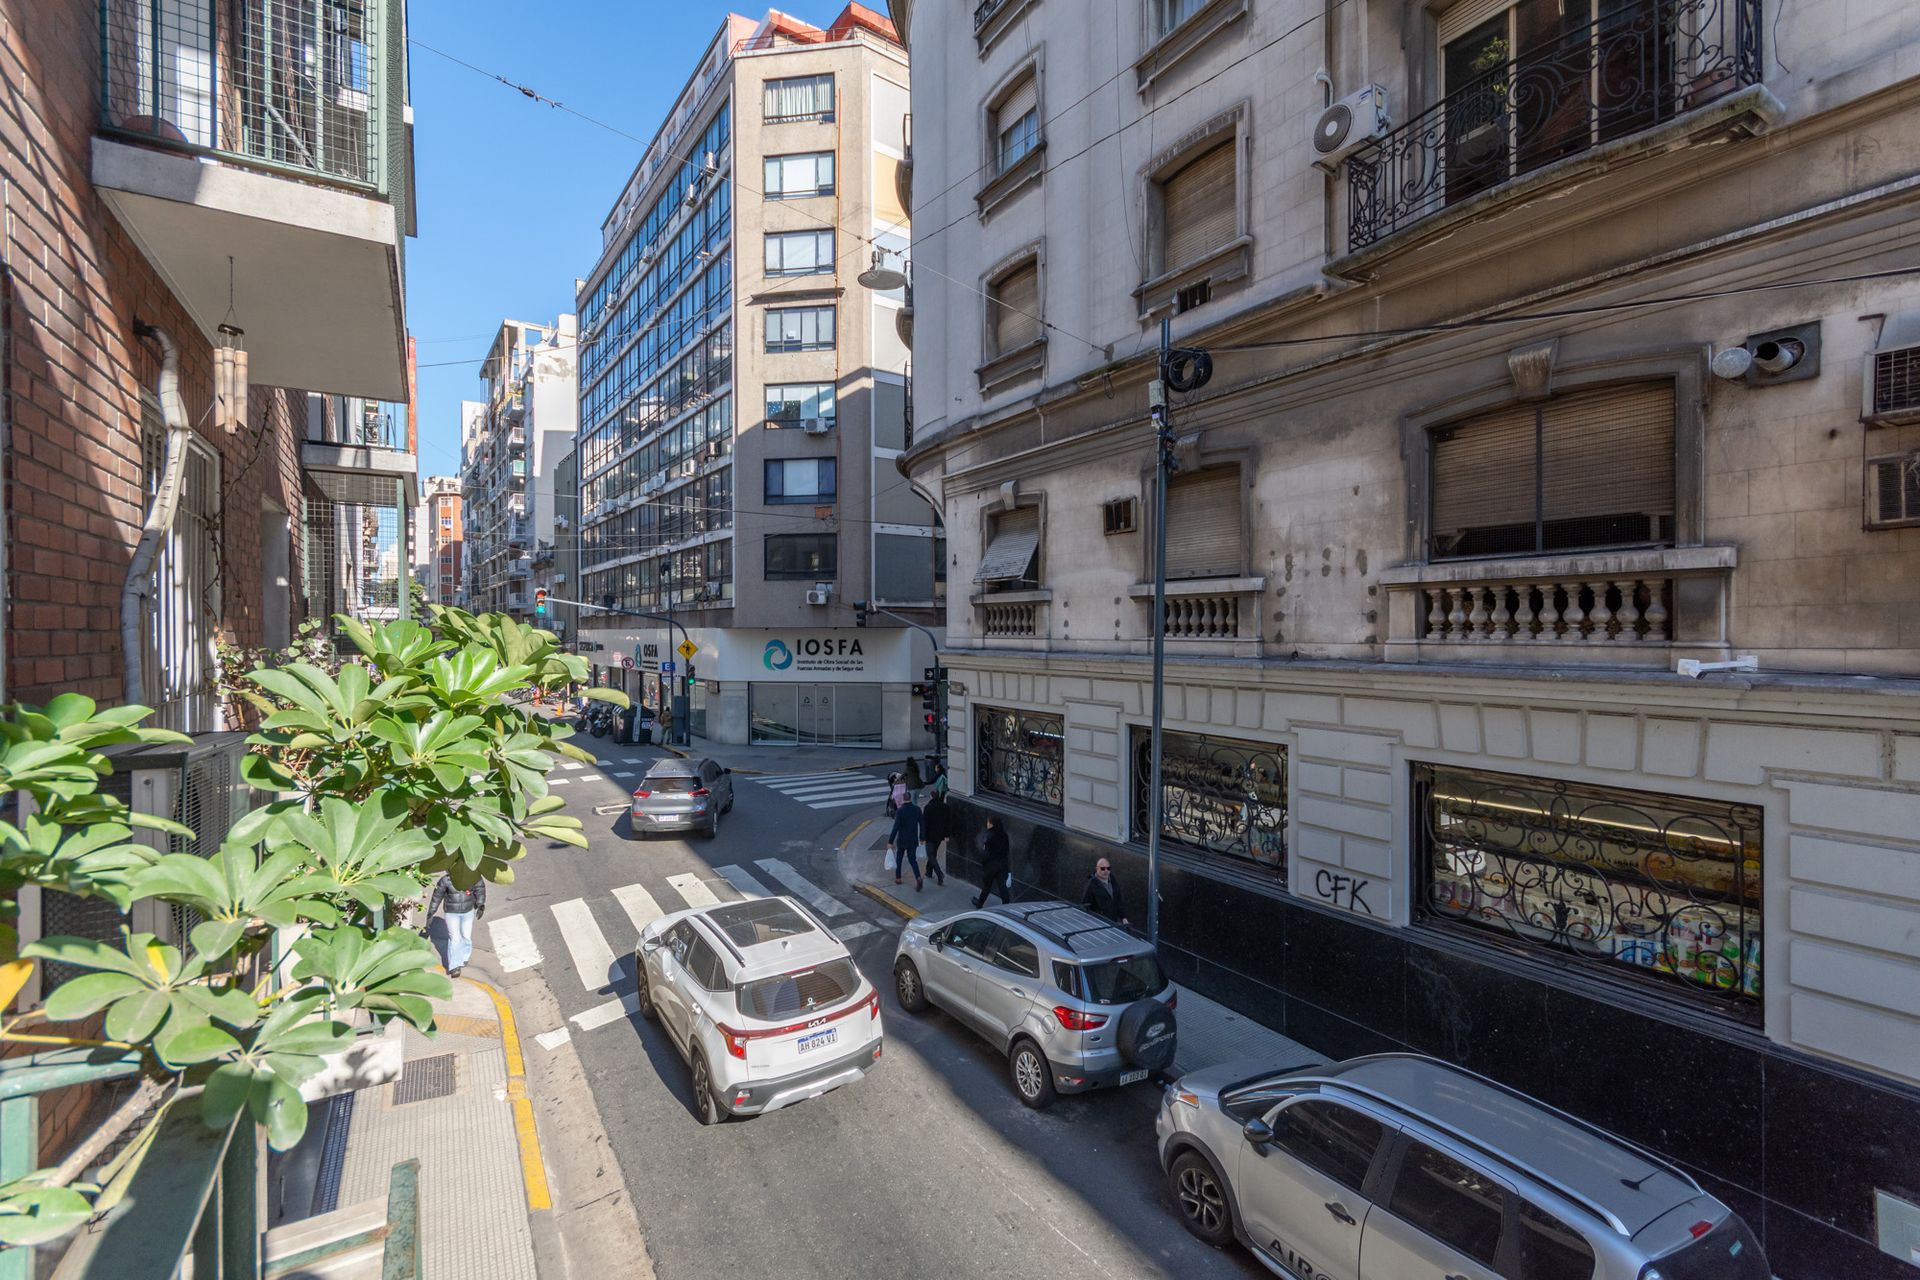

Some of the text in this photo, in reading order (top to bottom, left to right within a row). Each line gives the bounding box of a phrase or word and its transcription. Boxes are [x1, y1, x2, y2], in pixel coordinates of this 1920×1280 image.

[797, 639, 863, 655] IOSFA
[1316, 869, 1371, 914] CFK
[800, 1042, 810, 1051] AH
[811, 1037, 825, 1048] 824
